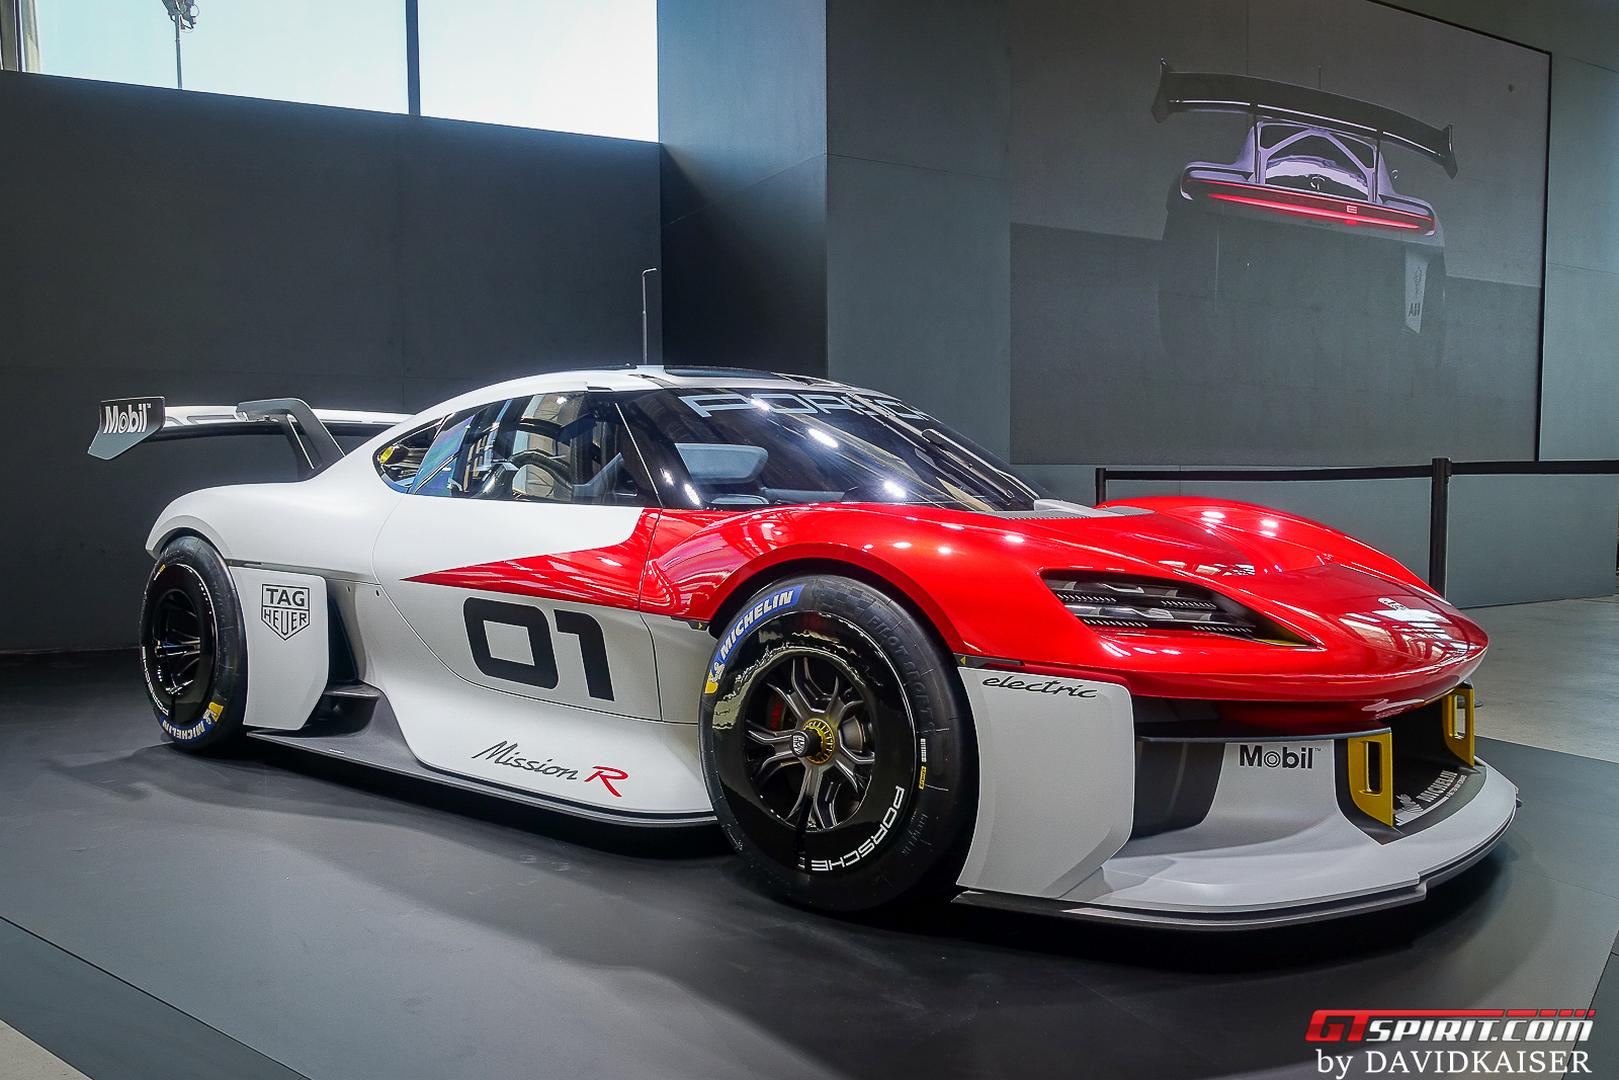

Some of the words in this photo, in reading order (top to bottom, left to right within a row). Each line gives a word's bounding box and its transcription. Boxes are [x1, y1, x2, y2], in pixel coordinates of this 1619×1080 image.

[265, 587, 305, 606] TAG
[264, 608, 307, 635] HEUER
[720, 590, 794, 660] MICHELIN
[463, 596, 615, 701] 01
[982, 675, 1098, 698] electric
[162, 720, 206, 740] MICHELIN
[471, 740, 579, 780] Mission
[584, 765, 629, 797] R
[811, 785, 905, 871] PORSCHE
